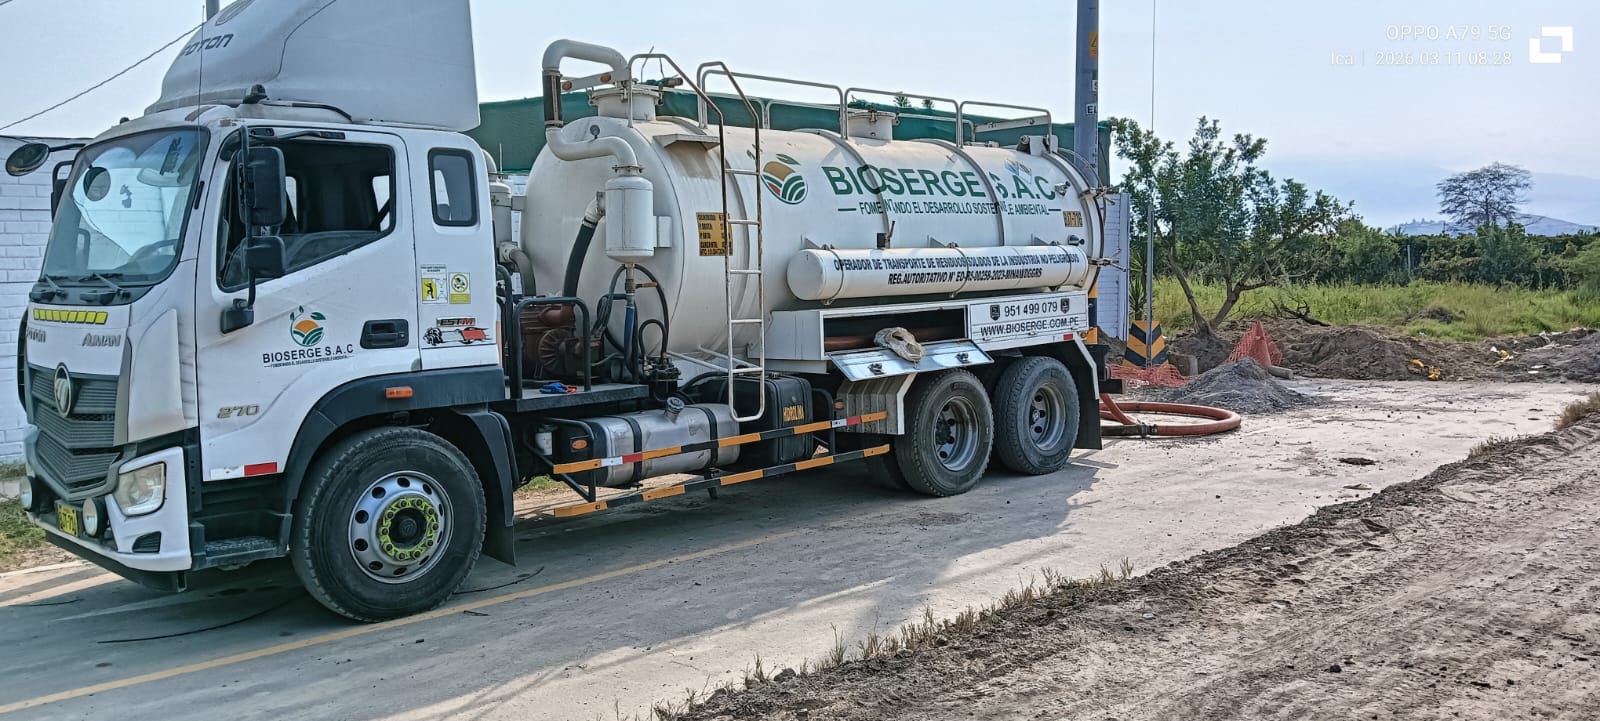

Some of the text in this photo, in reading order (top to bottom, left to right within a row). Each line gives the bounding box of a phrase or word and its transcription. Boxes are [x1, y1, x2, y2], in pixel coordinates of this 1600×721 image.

[821, 164, 1056, 201] BIOSERGE S.A.C
[913, 201, 924, 214] EL
[924, 202, 972, 215] DESARROLLO
[1014, 203, 1050, 216] AMBIENTAL
[834, 258, 872, 271] OPERADOR
[872, 259, 883, 270] DE
[884, 258, 926, 270] TRANSPORTE
[926, 258, 936, 269] DE
[935, 257, 967, 269] RESIDUOS
[993, 255, 999, 267] DE
[999, 255, 1008, 267] LA
[1041, 254, 1049, 265] NO
[1004, 305, 1020, 317] 951
[1023, 303, 1040, 315] 499
[1041, 301, 1058, 314] 079
[980, 316, 1079, 337] WWW.BIOSERGE.COM.PE
[262, 347, 322, 364] BIOSERGE
[324, 343, 354, 356] S.A.C
[216, 404, 260, 419] 270
